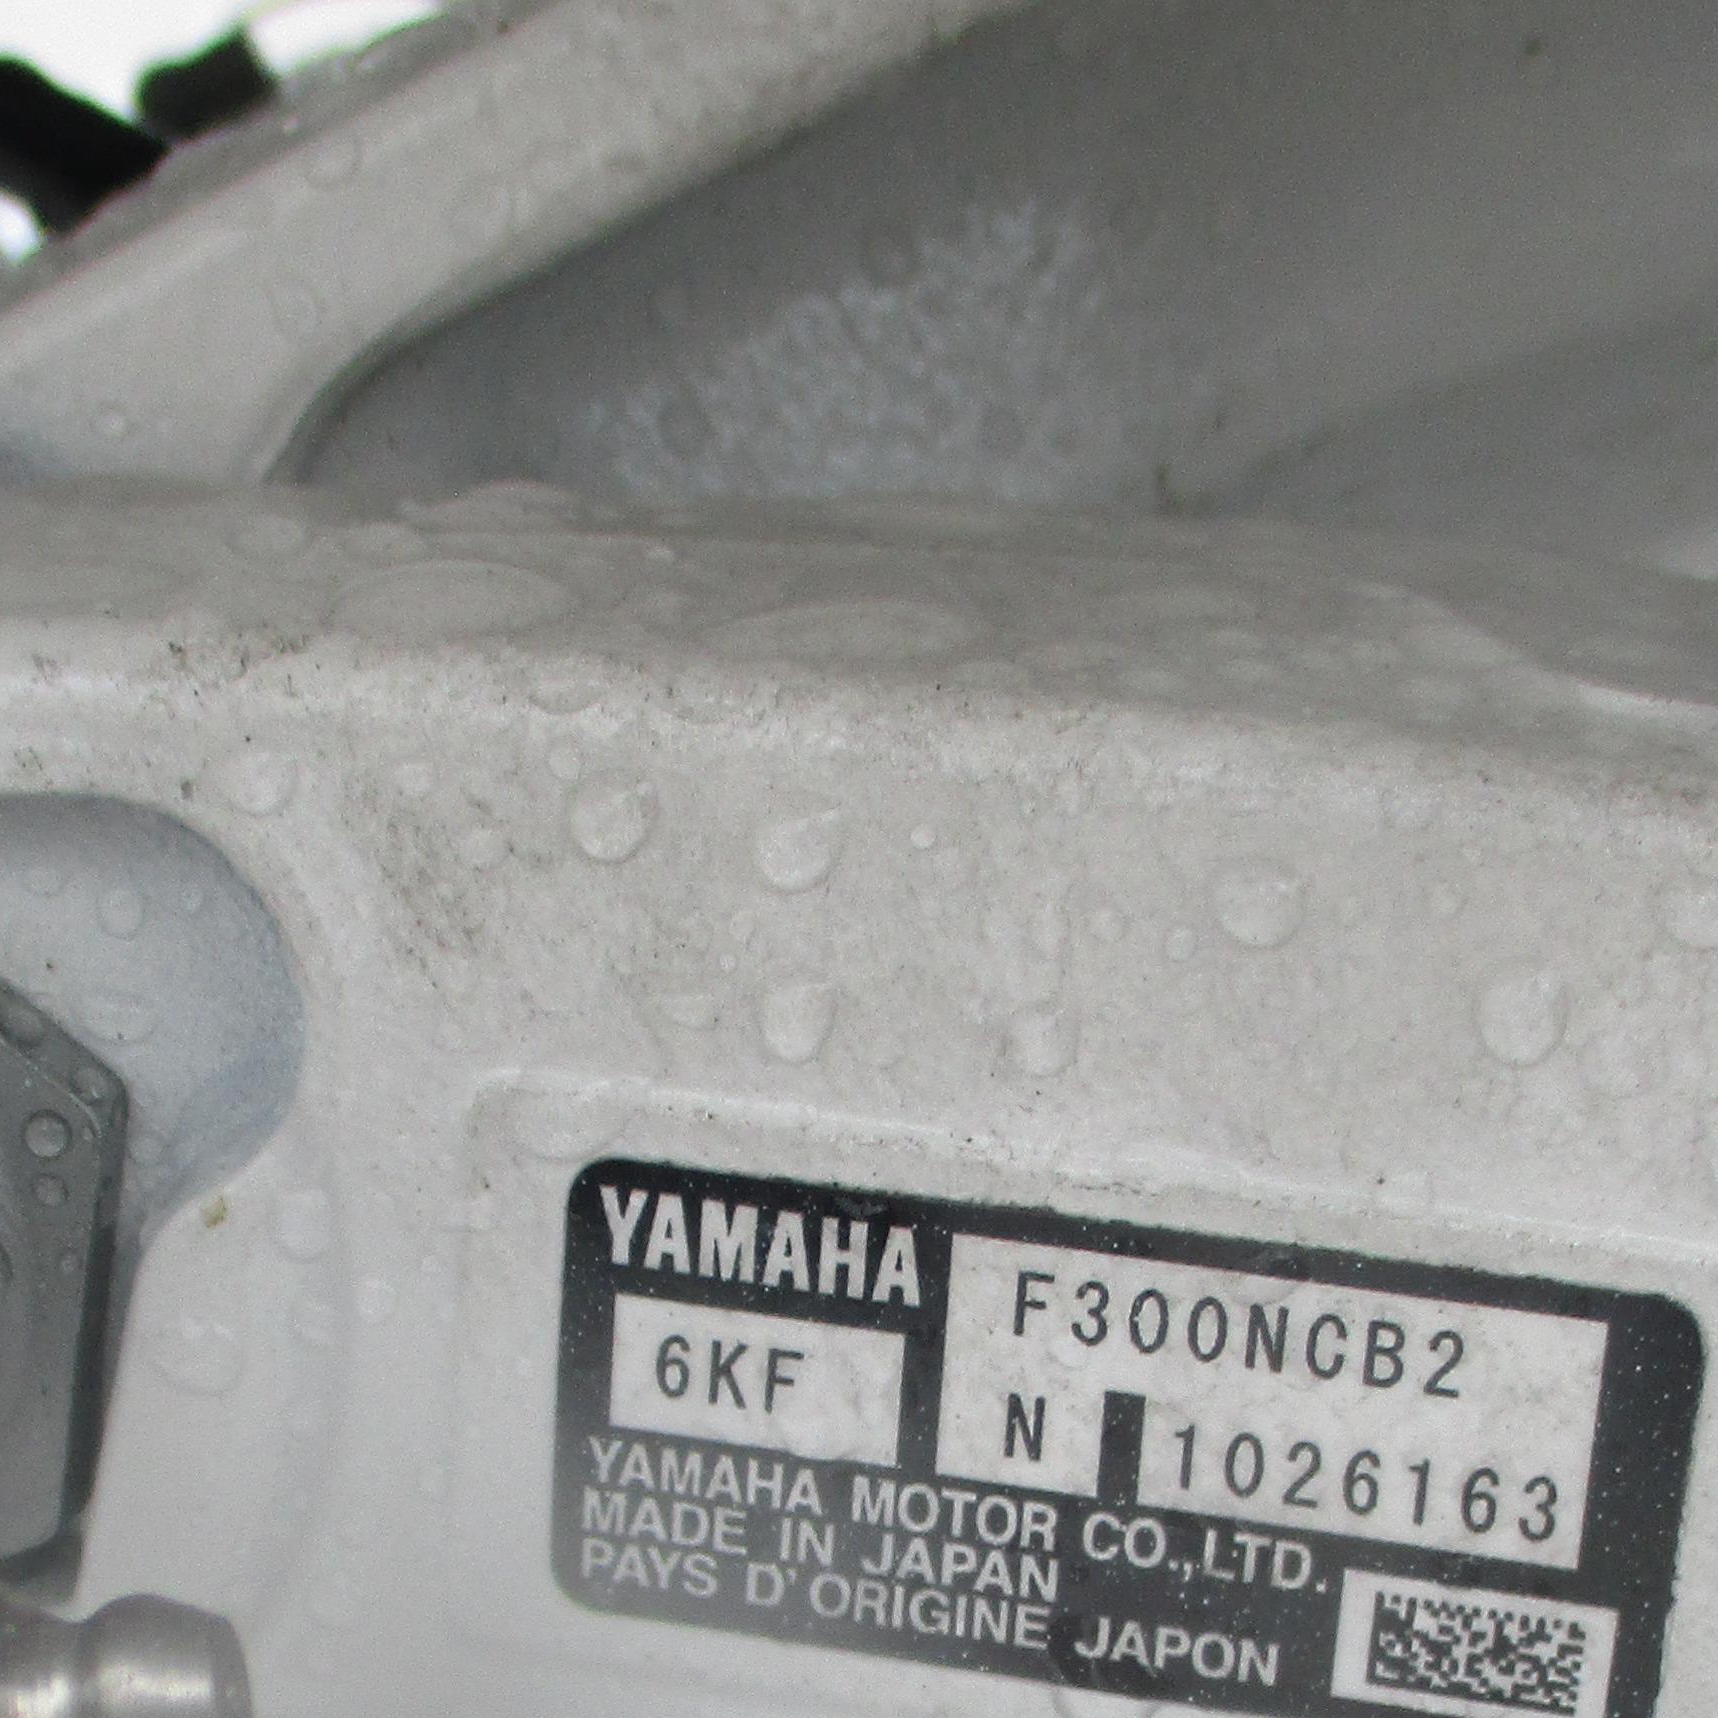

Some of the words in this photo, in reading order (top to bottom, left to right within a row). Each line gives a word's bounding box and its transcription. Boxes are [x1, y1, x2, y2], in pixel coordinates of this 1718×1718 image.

[599, 1184, 922, 1308] YAMAHA
[655, 1334, 807, 1415] 6KF
[1011, 1270, 1469, 1399] F300NCB2
[1004, 1394, 1046, 1462] N
[1173, 1428, 1562, 1540] 1026163
[582, 1486, 747, 1554] MADE
[781, 1517, 835, 1567] IN
[861, 1532, 1060, 1603] JAPAN
[589, 1436, 824, 1516] YAMAHA
[852, 1477, 1056, 1551] MOTOR
[580, 1539, 718, 1596] PAYS
[1074, 1615, 1280, 1687] JAPON
